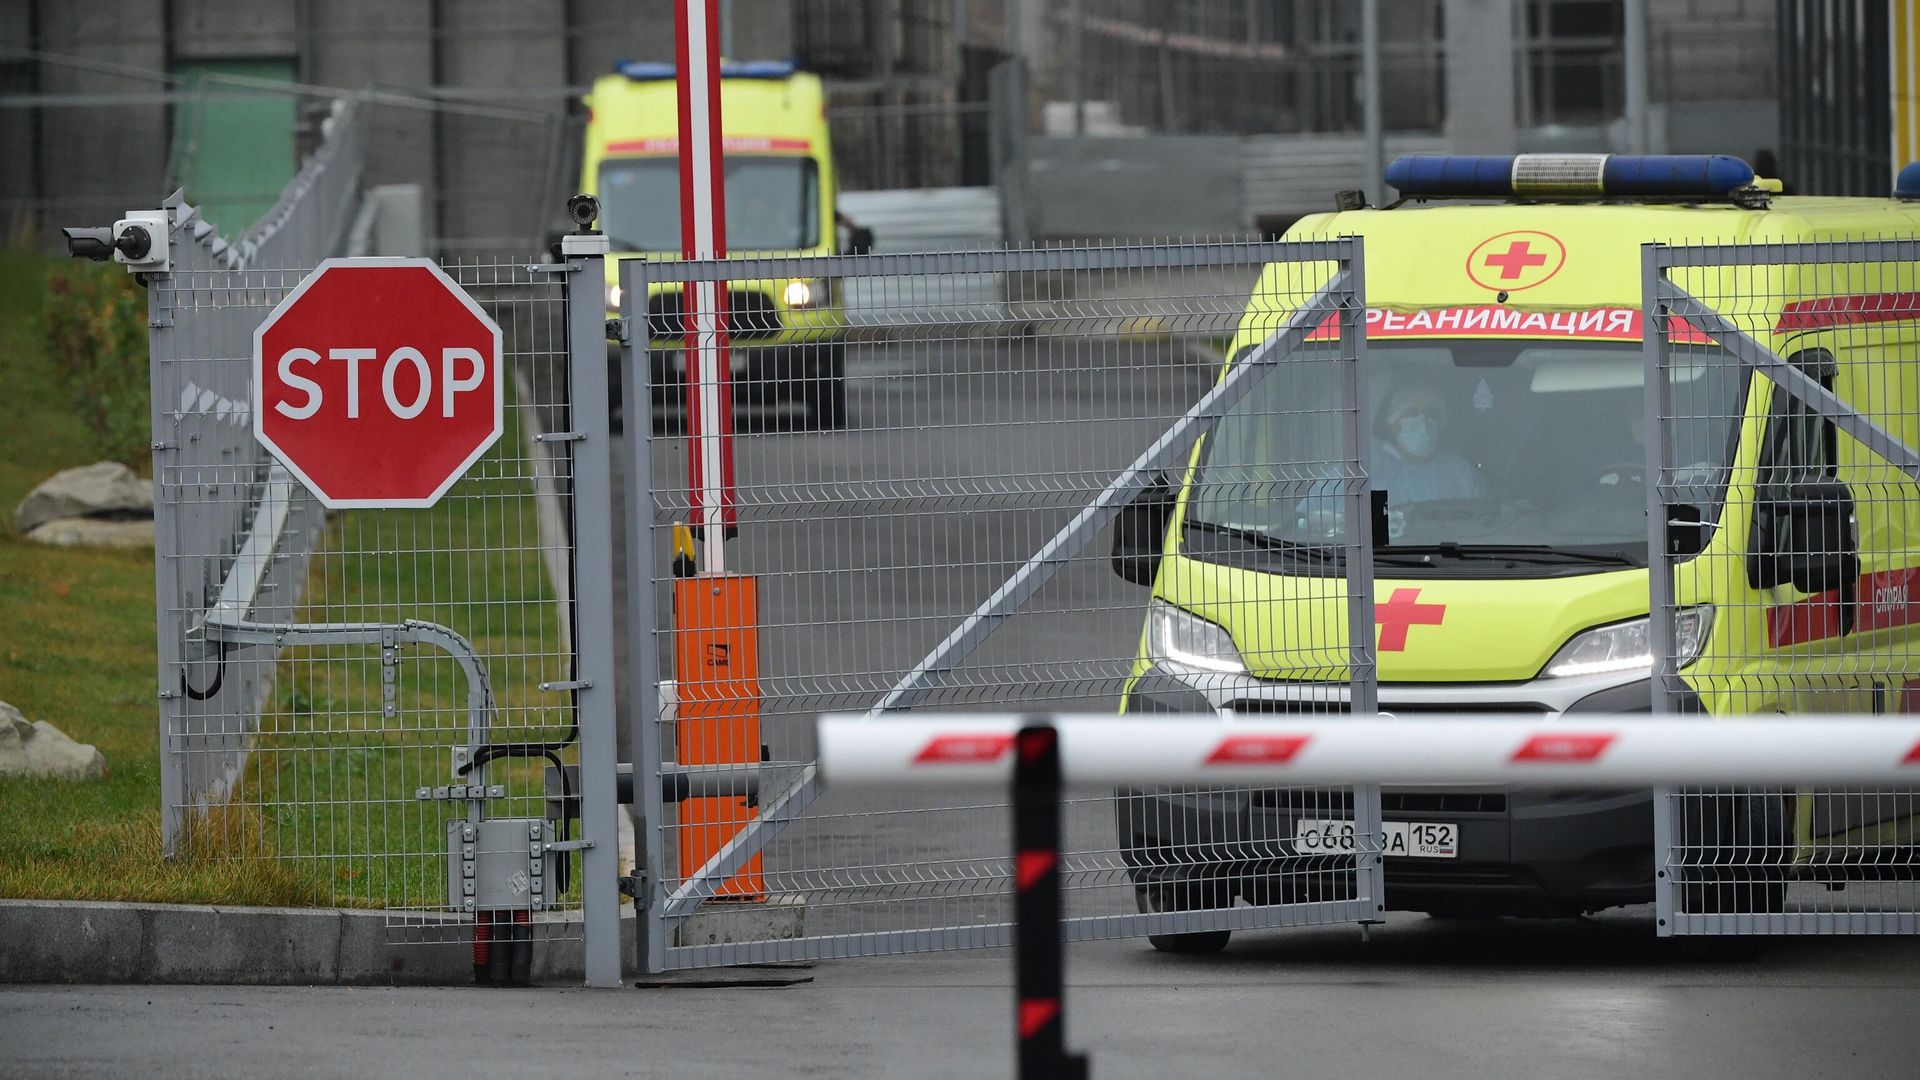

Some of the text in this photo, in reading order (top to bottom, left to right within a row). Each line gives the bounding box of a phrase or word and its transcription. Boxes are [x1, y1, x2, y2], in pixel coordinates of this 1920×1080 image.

[1365, 308, 1633, 334] РЕАНИМАЦИЯ
[274, 346, 485, 420] STOP
[1412, 825, 1450, 846] 152
[1420, 845, 1439, 853] RUS
